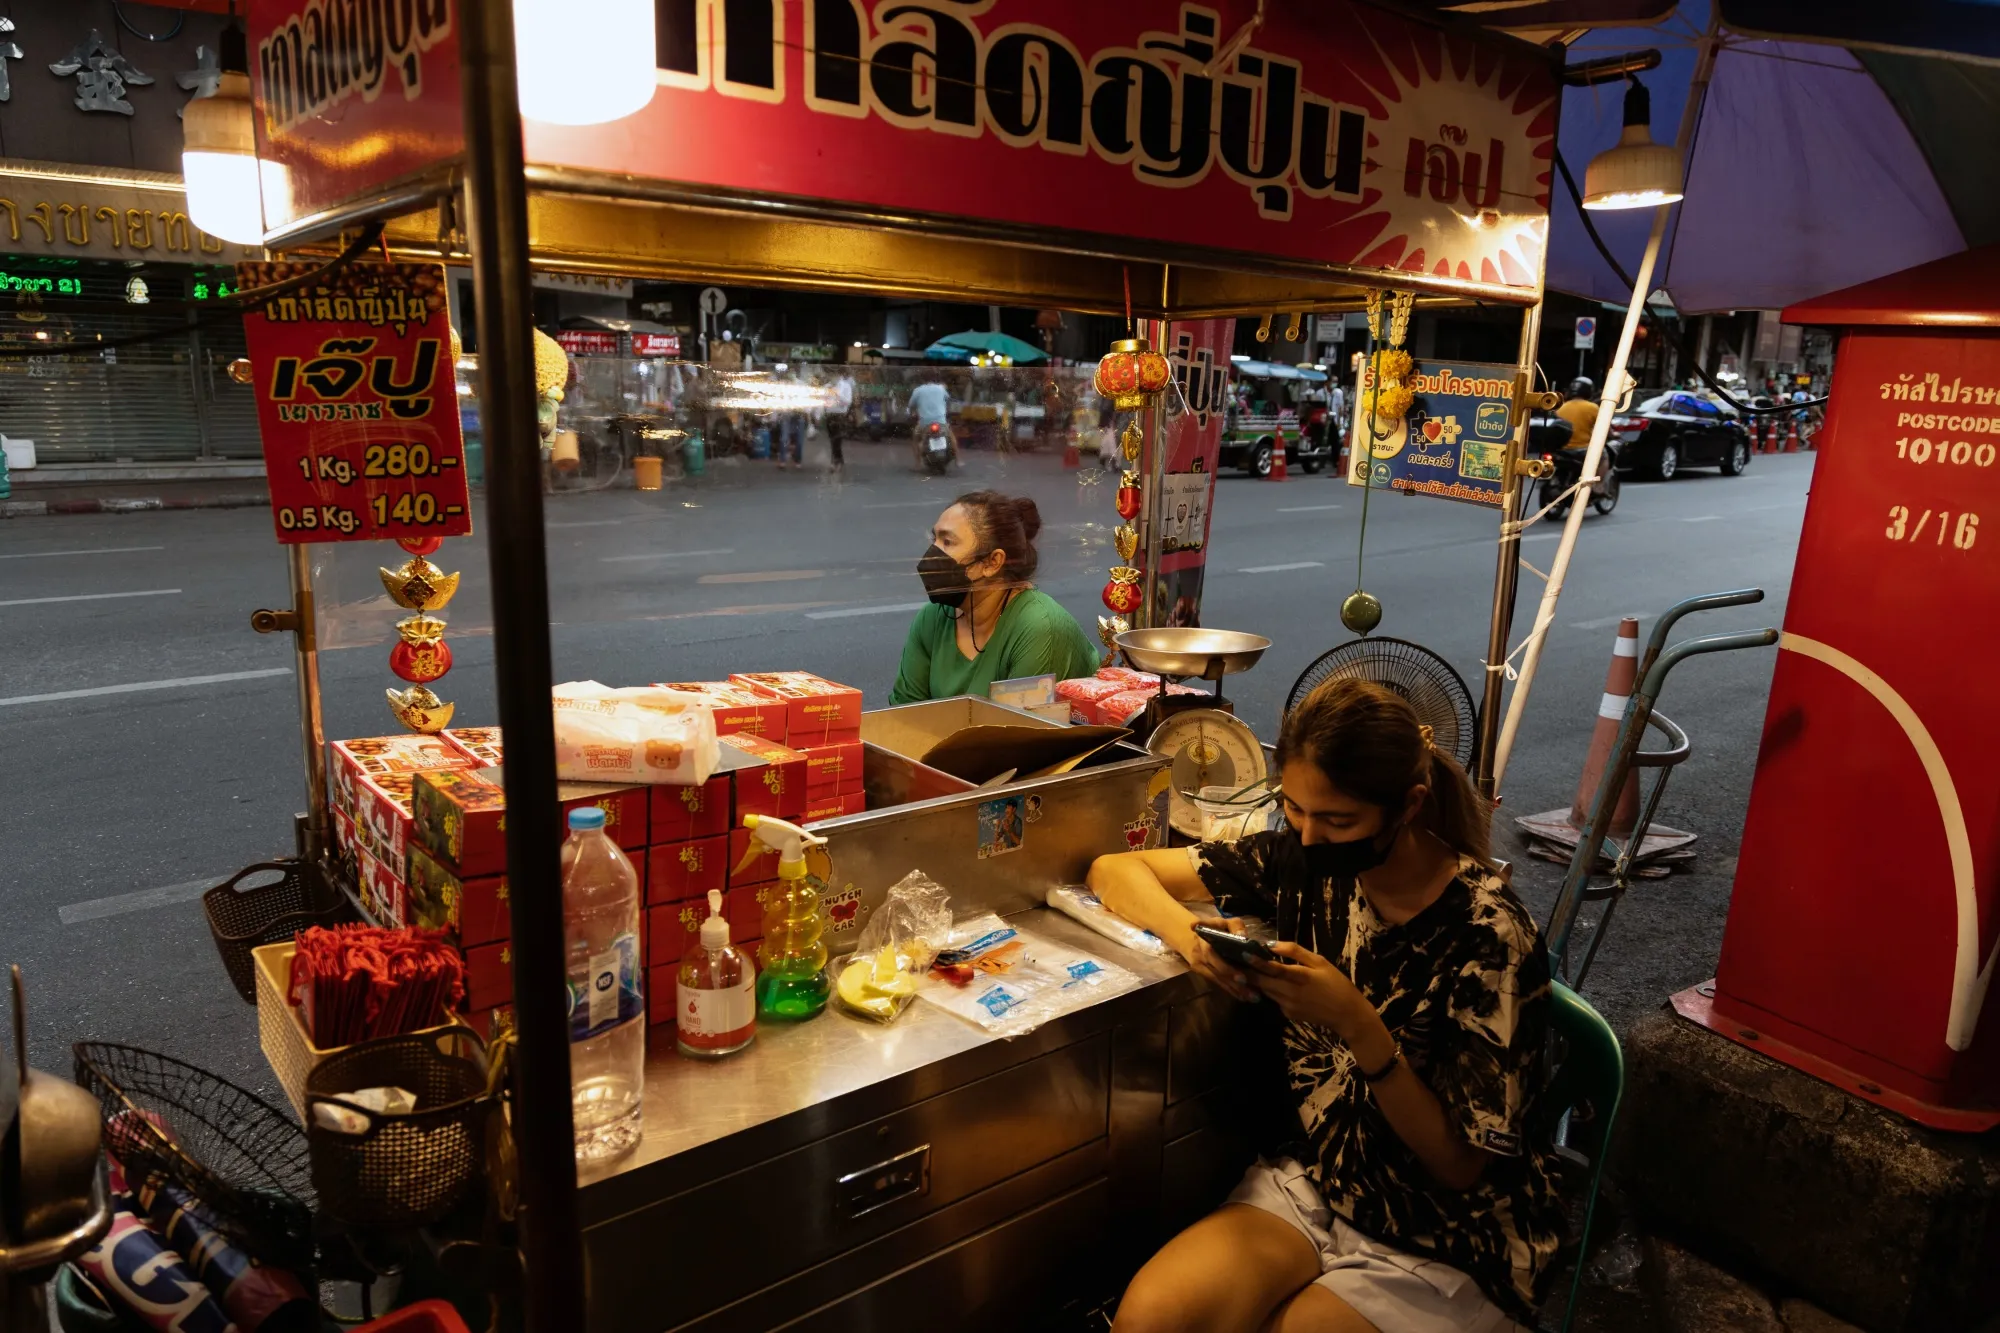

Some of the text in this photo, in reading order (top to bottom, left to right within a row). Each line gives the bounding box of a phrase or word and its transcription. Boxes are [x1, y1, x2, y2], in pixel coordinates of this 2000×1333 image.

[266, 277, 428, 336] เกาลัดญี่ปุ่น
[1443, 425, 1453, 434] 50
[1897, 412, 2000, 434] POSTCODE
[1416, 435, 1426, 444] 50
[1896, 437, 1996, 467] 10100
[300, 444, 456, 484] 1 Kg. 280.-
[280, 492, 462, 533] 0.5 Kg. 140.-
[1885, 505, 1980, 550] 3/16
[824, 888, 863, 907] NUTCH
[833, 919, 855, 933] CAR
[598, 976, 613, 987] NSF
